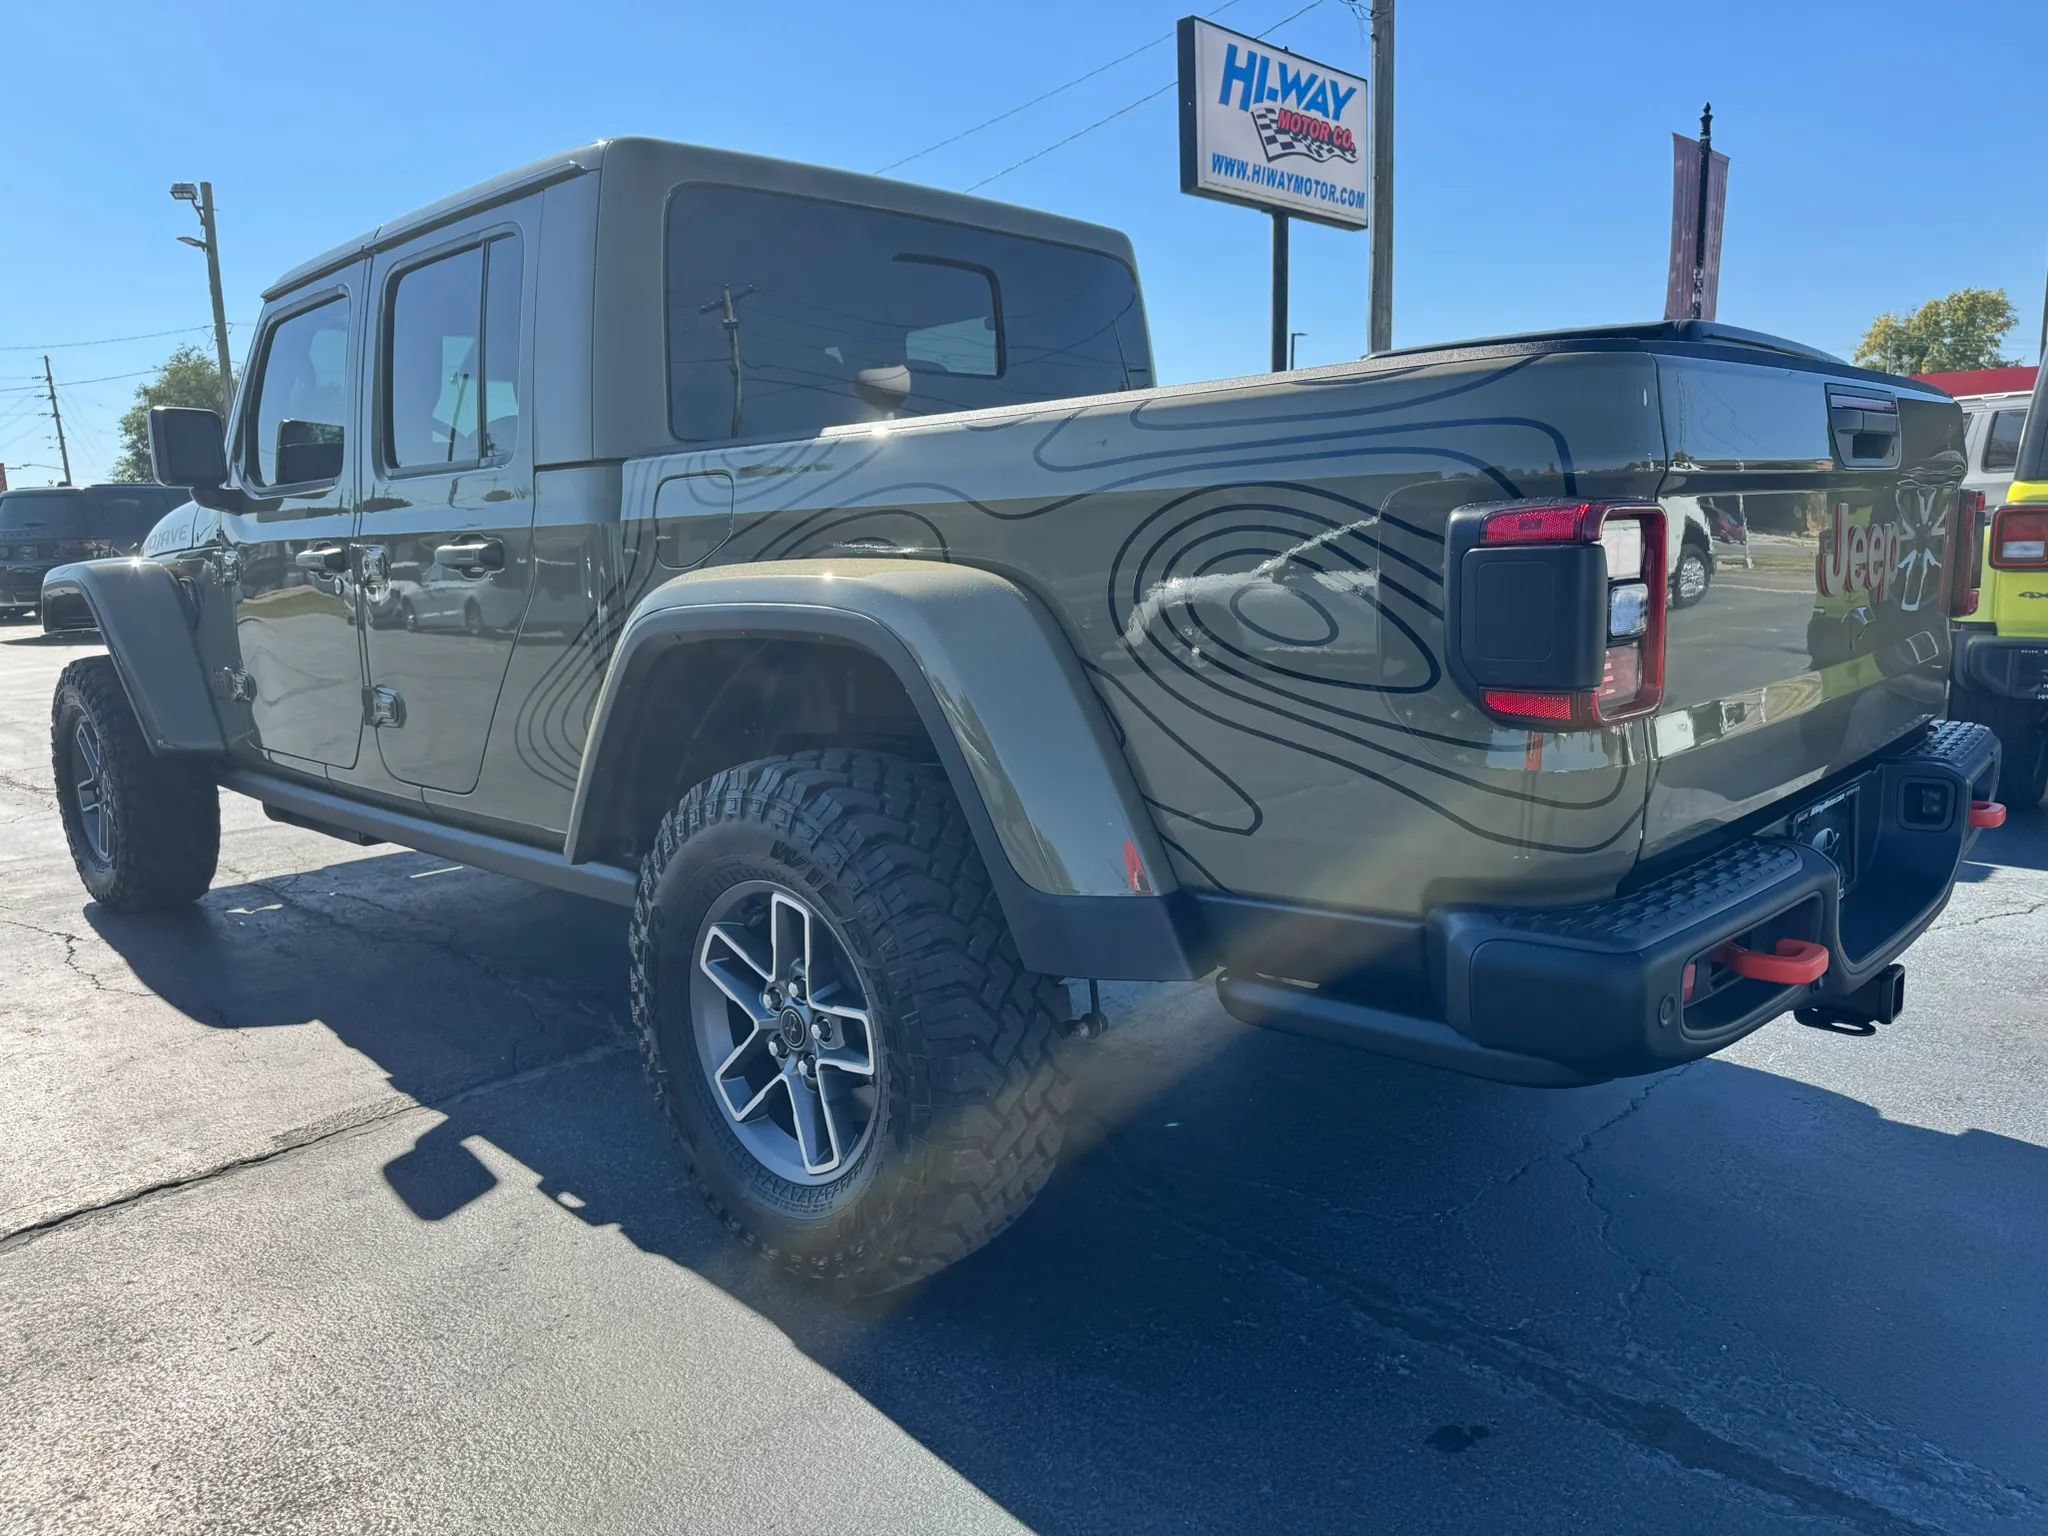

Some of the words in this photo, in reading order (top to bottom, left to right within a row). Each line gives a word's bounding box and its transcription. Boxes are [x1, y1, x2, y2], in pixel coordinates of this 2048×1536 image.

[1219, 44, 1356, 120] HI-WAY
[1276, 107, 1330, 142] MOTOR
[1333, 126, 1357, 151] CO.
[1212, 154, 1364, 209] WWW.HIWAYMOTOR.COM
[1819, 502, 1900, 604] Jeep
